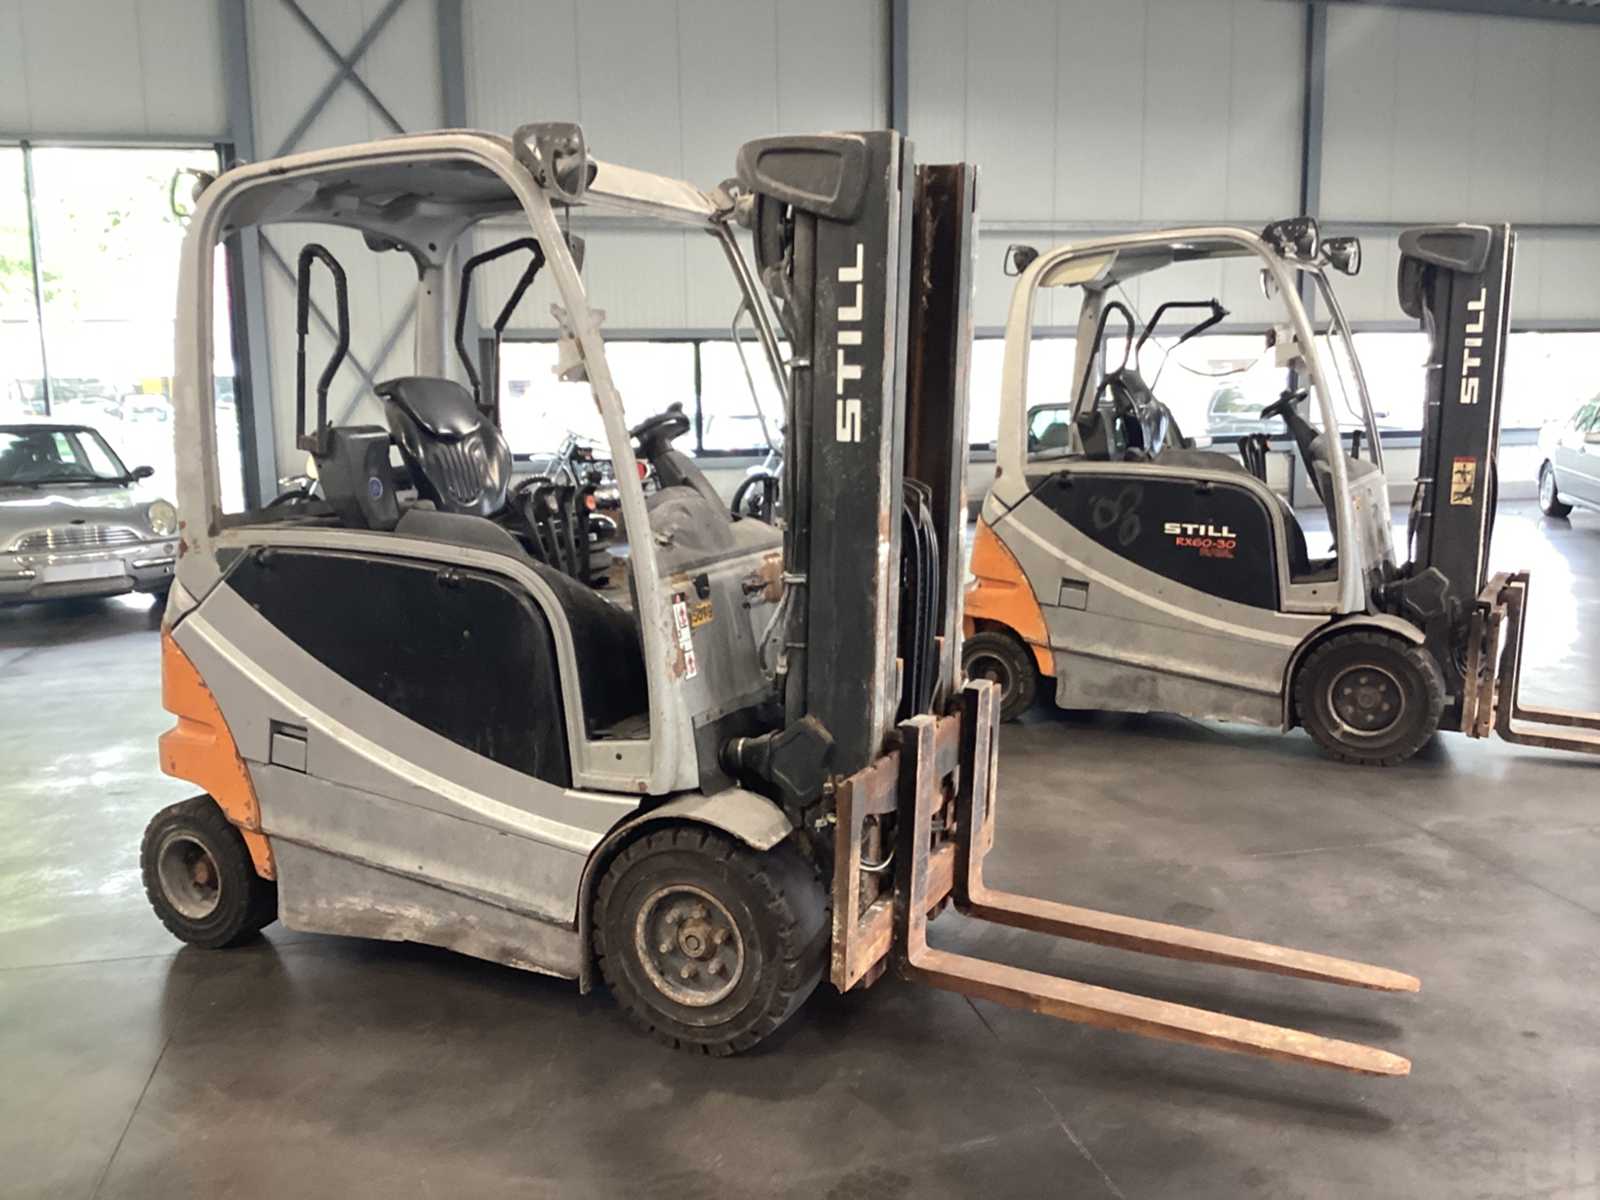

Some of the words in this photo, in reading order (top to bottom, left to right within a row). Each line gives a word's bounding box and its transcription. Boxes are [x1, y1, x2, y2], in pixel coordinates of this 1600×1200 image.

[836, 243, 864, 443] STILL
[1460, 287, 1487, 404] STILL
[1164, 522, 1237, 537] STILL
